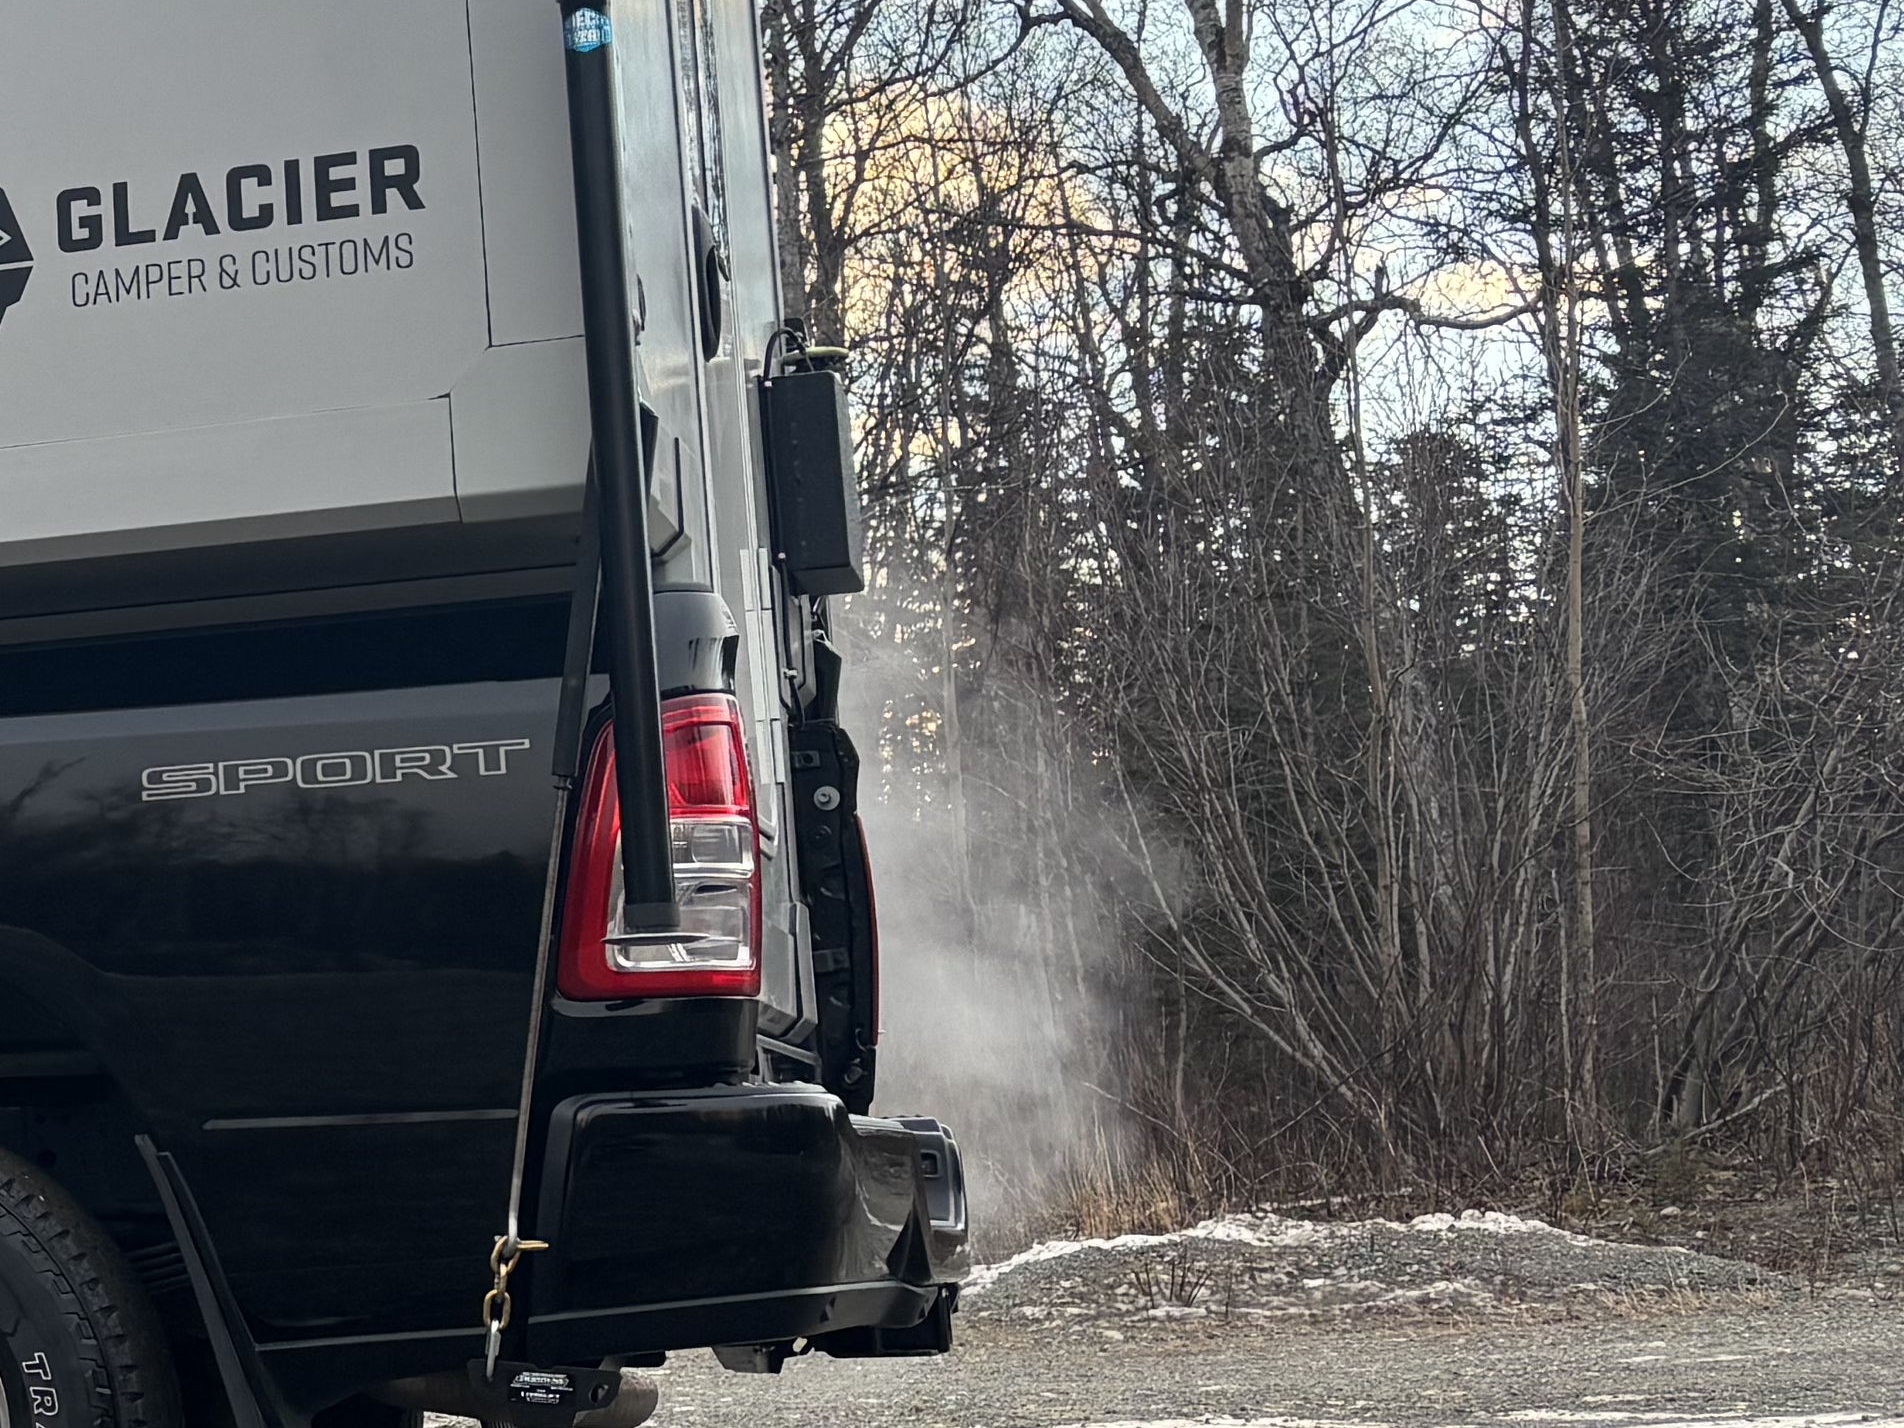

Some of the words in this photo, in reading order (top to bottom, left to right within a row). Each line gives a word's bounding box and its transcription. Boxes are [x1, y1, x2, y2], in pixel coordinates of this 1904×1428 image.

[56, 144, 426, 253] GLACIER
[71, 258, 207, 308] CAMPER
[218, 254, 241, 289] &
[251, 232, 415, 286] CUSTOMS
[141, 738, 531, 801] SPORT
